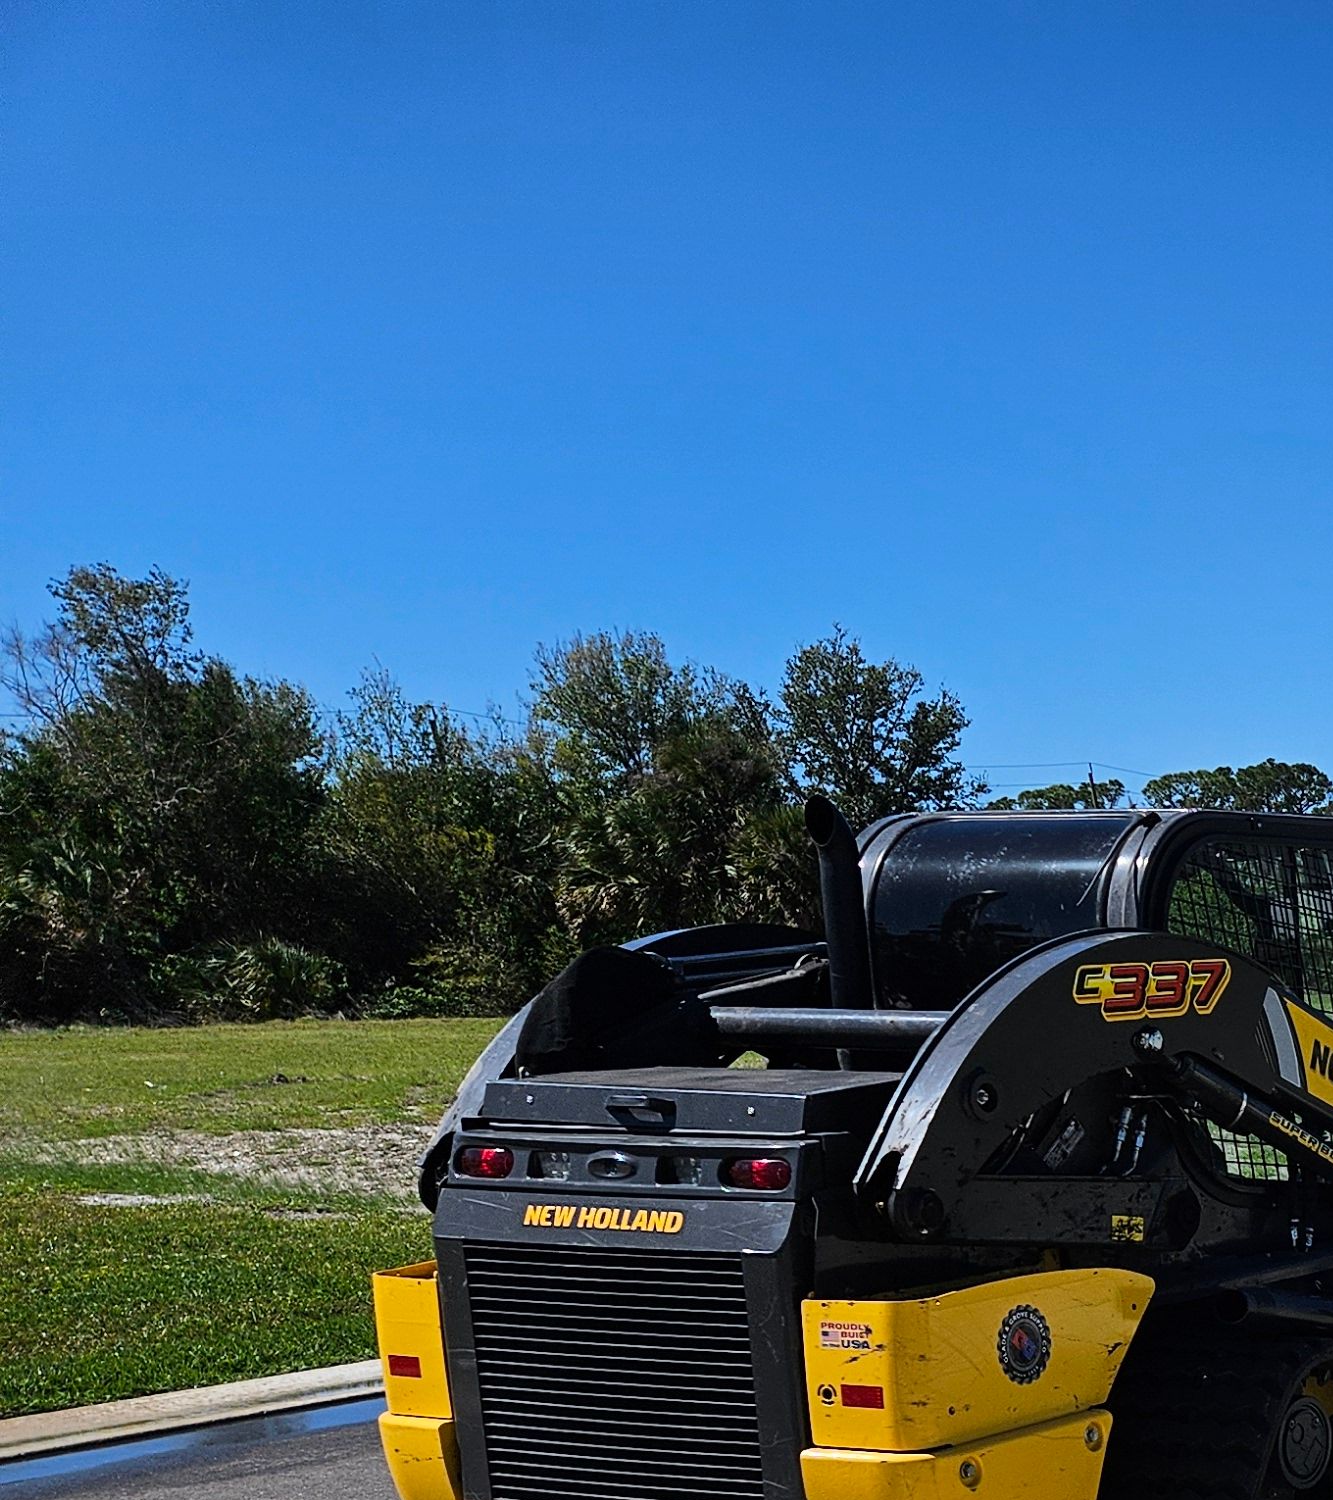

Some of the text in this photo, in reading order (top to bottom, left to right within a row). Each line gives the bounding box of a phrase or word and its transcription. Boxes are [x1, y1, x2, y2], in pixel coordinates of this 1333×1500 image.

[1073, 959, 1232, 1022] C337
[1269, 1111, 1318, 1152] SUPER
[523, 1204, 685, 1234] NEW HOLLAND
[820, 1322, 870, 1331] PROUDLY
[1001, 1334, 1009, 1364] GLADE
[1008, 1311, 1028, 1325] GROVE
[1029, 1313, 1046, 1337] SUPPLY
[841, 1339, 871, 1350] USA
